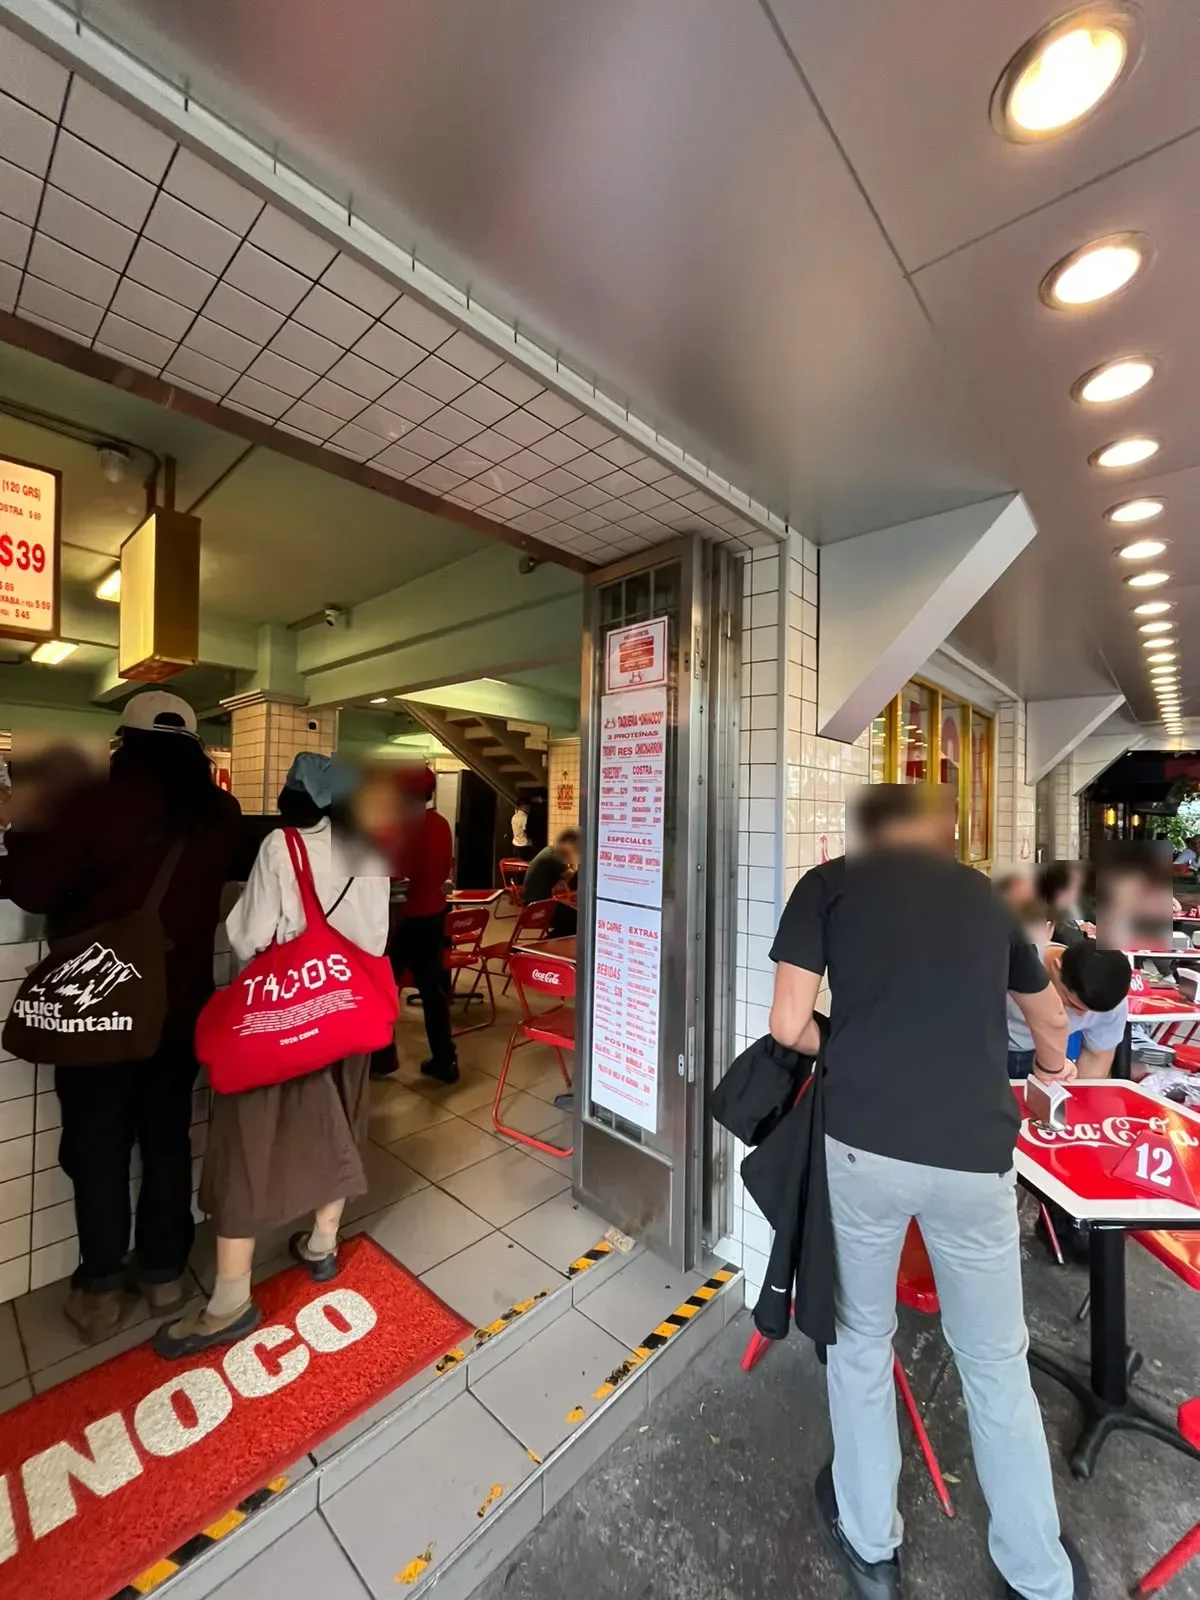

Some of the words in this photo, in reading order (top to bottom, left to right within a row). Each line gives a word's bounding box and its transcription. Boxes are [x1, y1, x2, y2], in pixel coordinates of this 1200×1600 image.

[614, 730, 659, 739] PROTEÍNAS
[618, 747, 632, 756] RES
[633, 765, 652, 775] COSTRA
[607, 836, 652, 845] ESPECIALES
[629, 926, 658, 940] EXTRAS
[243, 954, 352, 1006] TACOS
[13, 997, 62, 1019] quiet
[26, 1012, 133, 1033] mountain
[1136, 1142, 1173, 1187] 12
